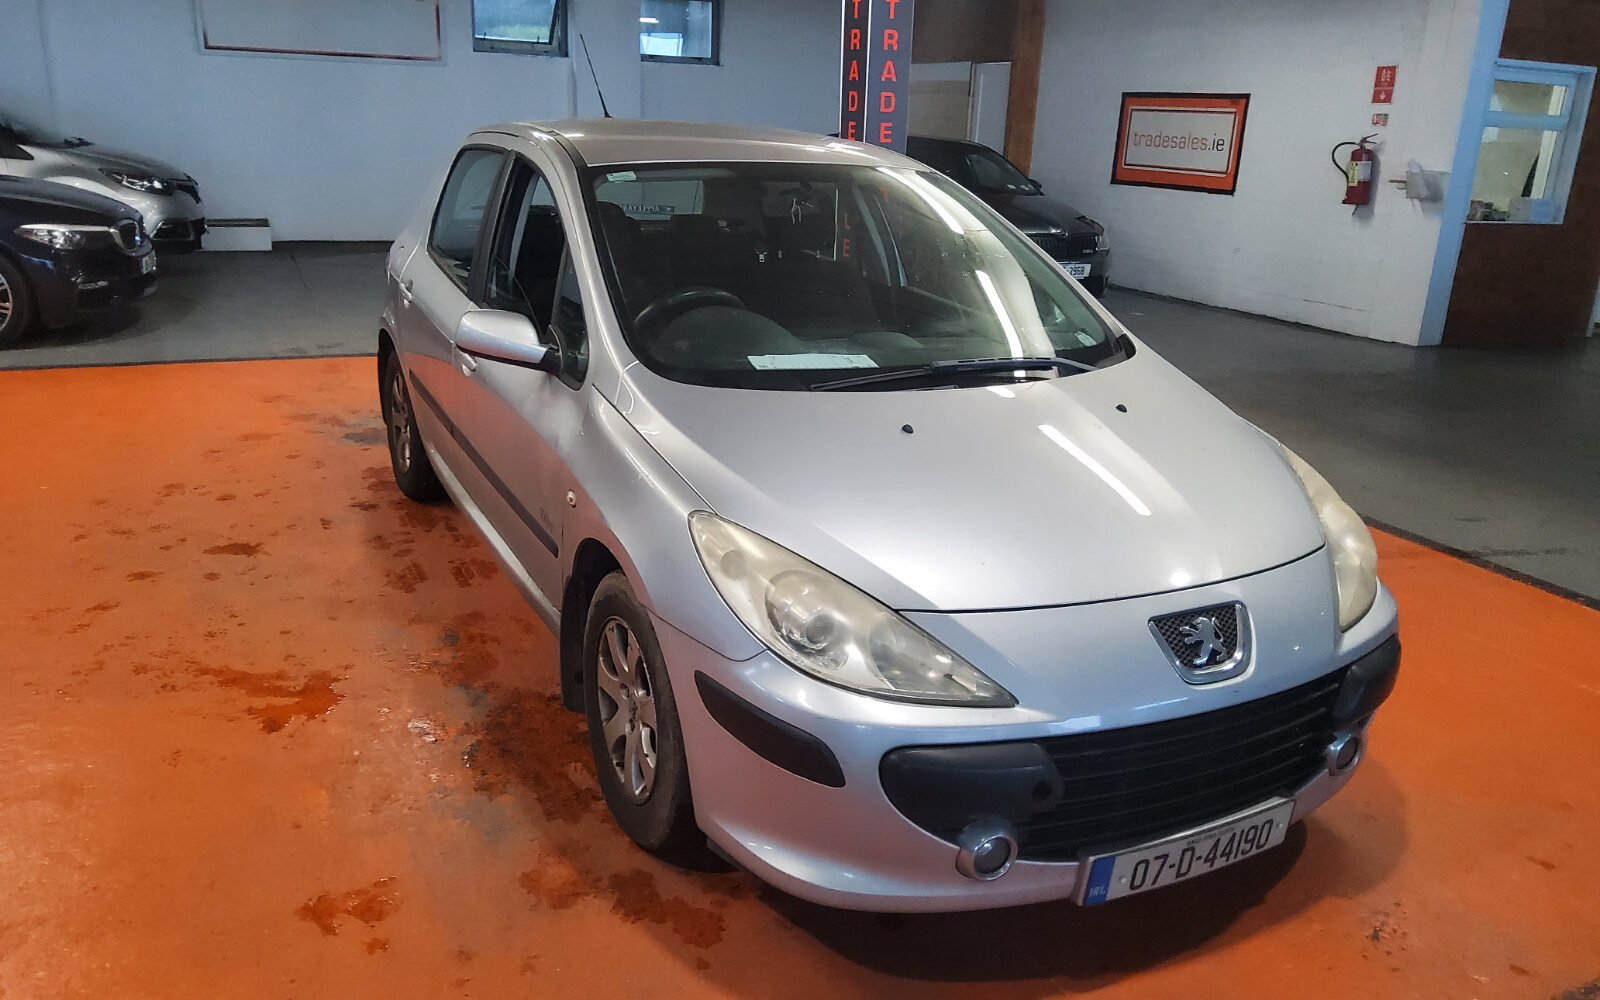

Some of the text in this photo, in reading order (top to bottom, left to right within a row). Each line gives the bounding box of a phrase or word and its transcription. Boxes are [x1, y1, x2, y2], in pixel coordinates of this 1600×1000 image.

[848, 0, 860, 141] TRADE
[880, 0, 899, 143] TRADE
[1133, 130, 1225, 152] tradesales.ie
[1129, 818, 1274, 891] 07-D-44190
[1088, 885, 1107, 898] IRL
